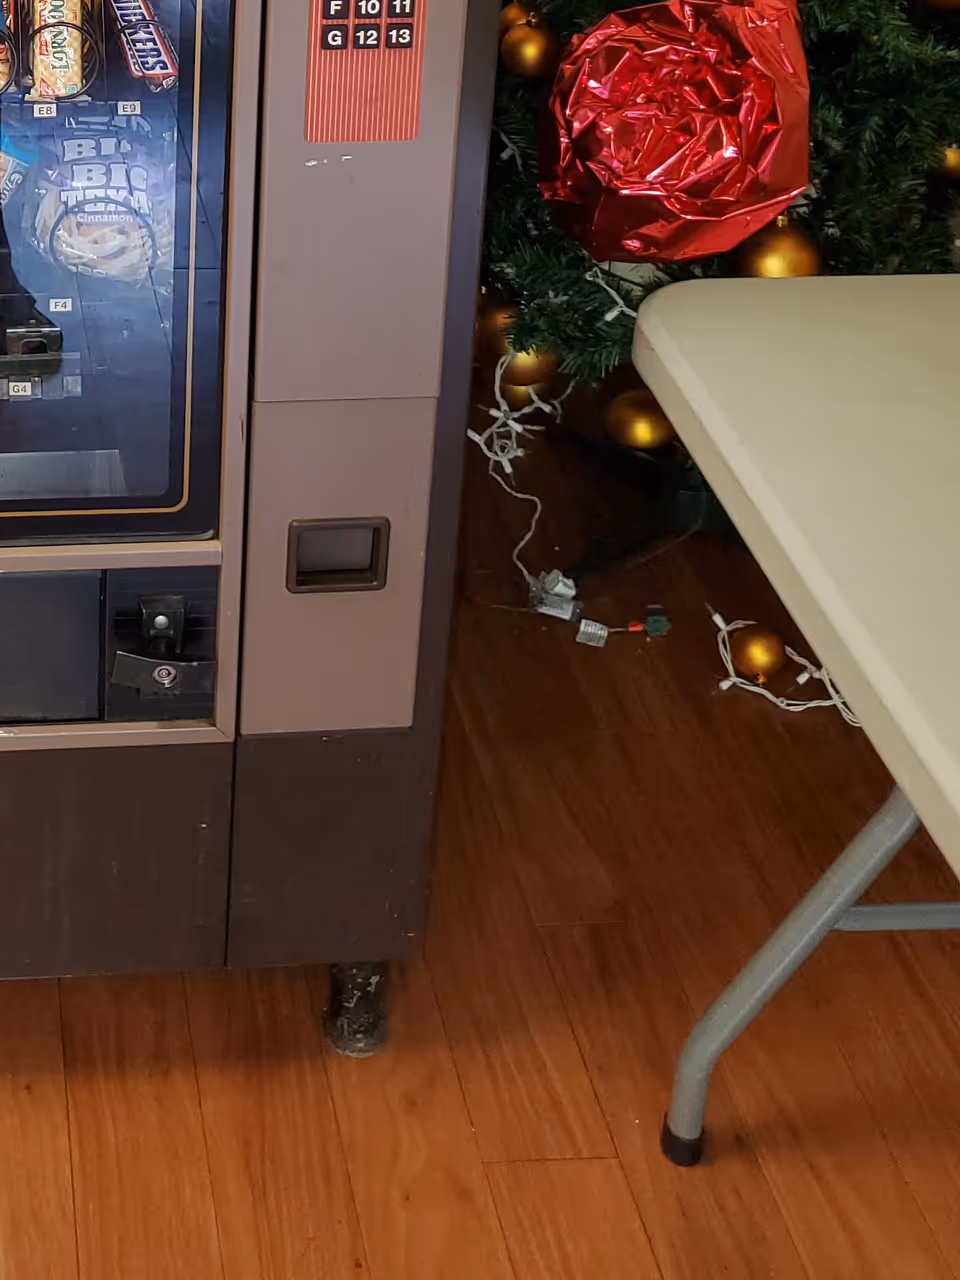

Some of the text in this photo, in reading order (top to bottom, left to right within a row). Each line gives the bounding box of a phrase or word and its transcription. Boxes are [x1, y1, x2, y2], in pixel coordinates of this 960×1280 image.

[331, 0, 411, 15] F 10 11
[327, 29, 411, 46] G 12 13
[39, 107, 53, 116] E8
[122, 104, 136, 113] E9
[76, 213, 134, 224] Cinnamon
[54, 301, 67, 310] F4
[12, 384, 27, 394] G4
